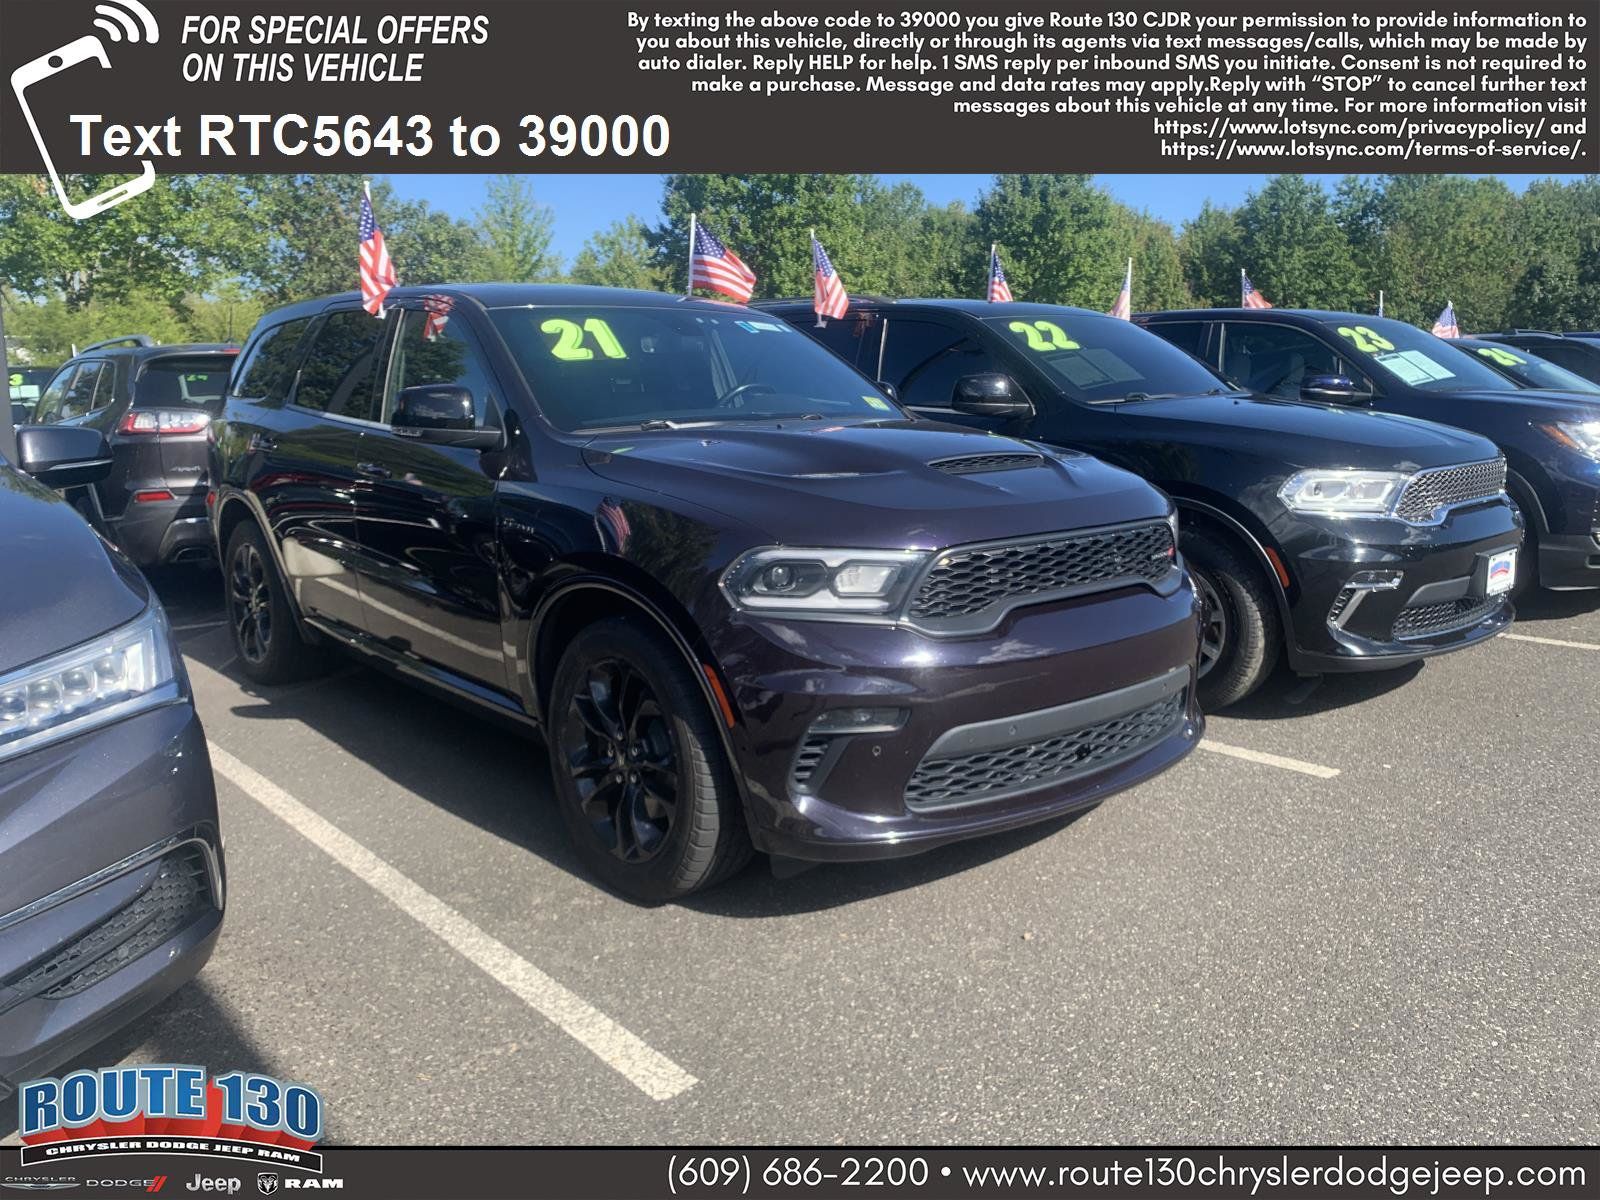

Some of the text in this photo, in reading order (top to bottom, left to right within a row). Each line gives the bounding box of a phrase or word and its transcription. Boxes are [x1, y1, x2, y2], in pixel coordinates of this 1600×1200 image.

[540, 318, 627, 361] 21
[1008, 320, 1081, 352] 22
[1337, 326, 1395, 352] 23
[9, 373, 24, 386] 3
